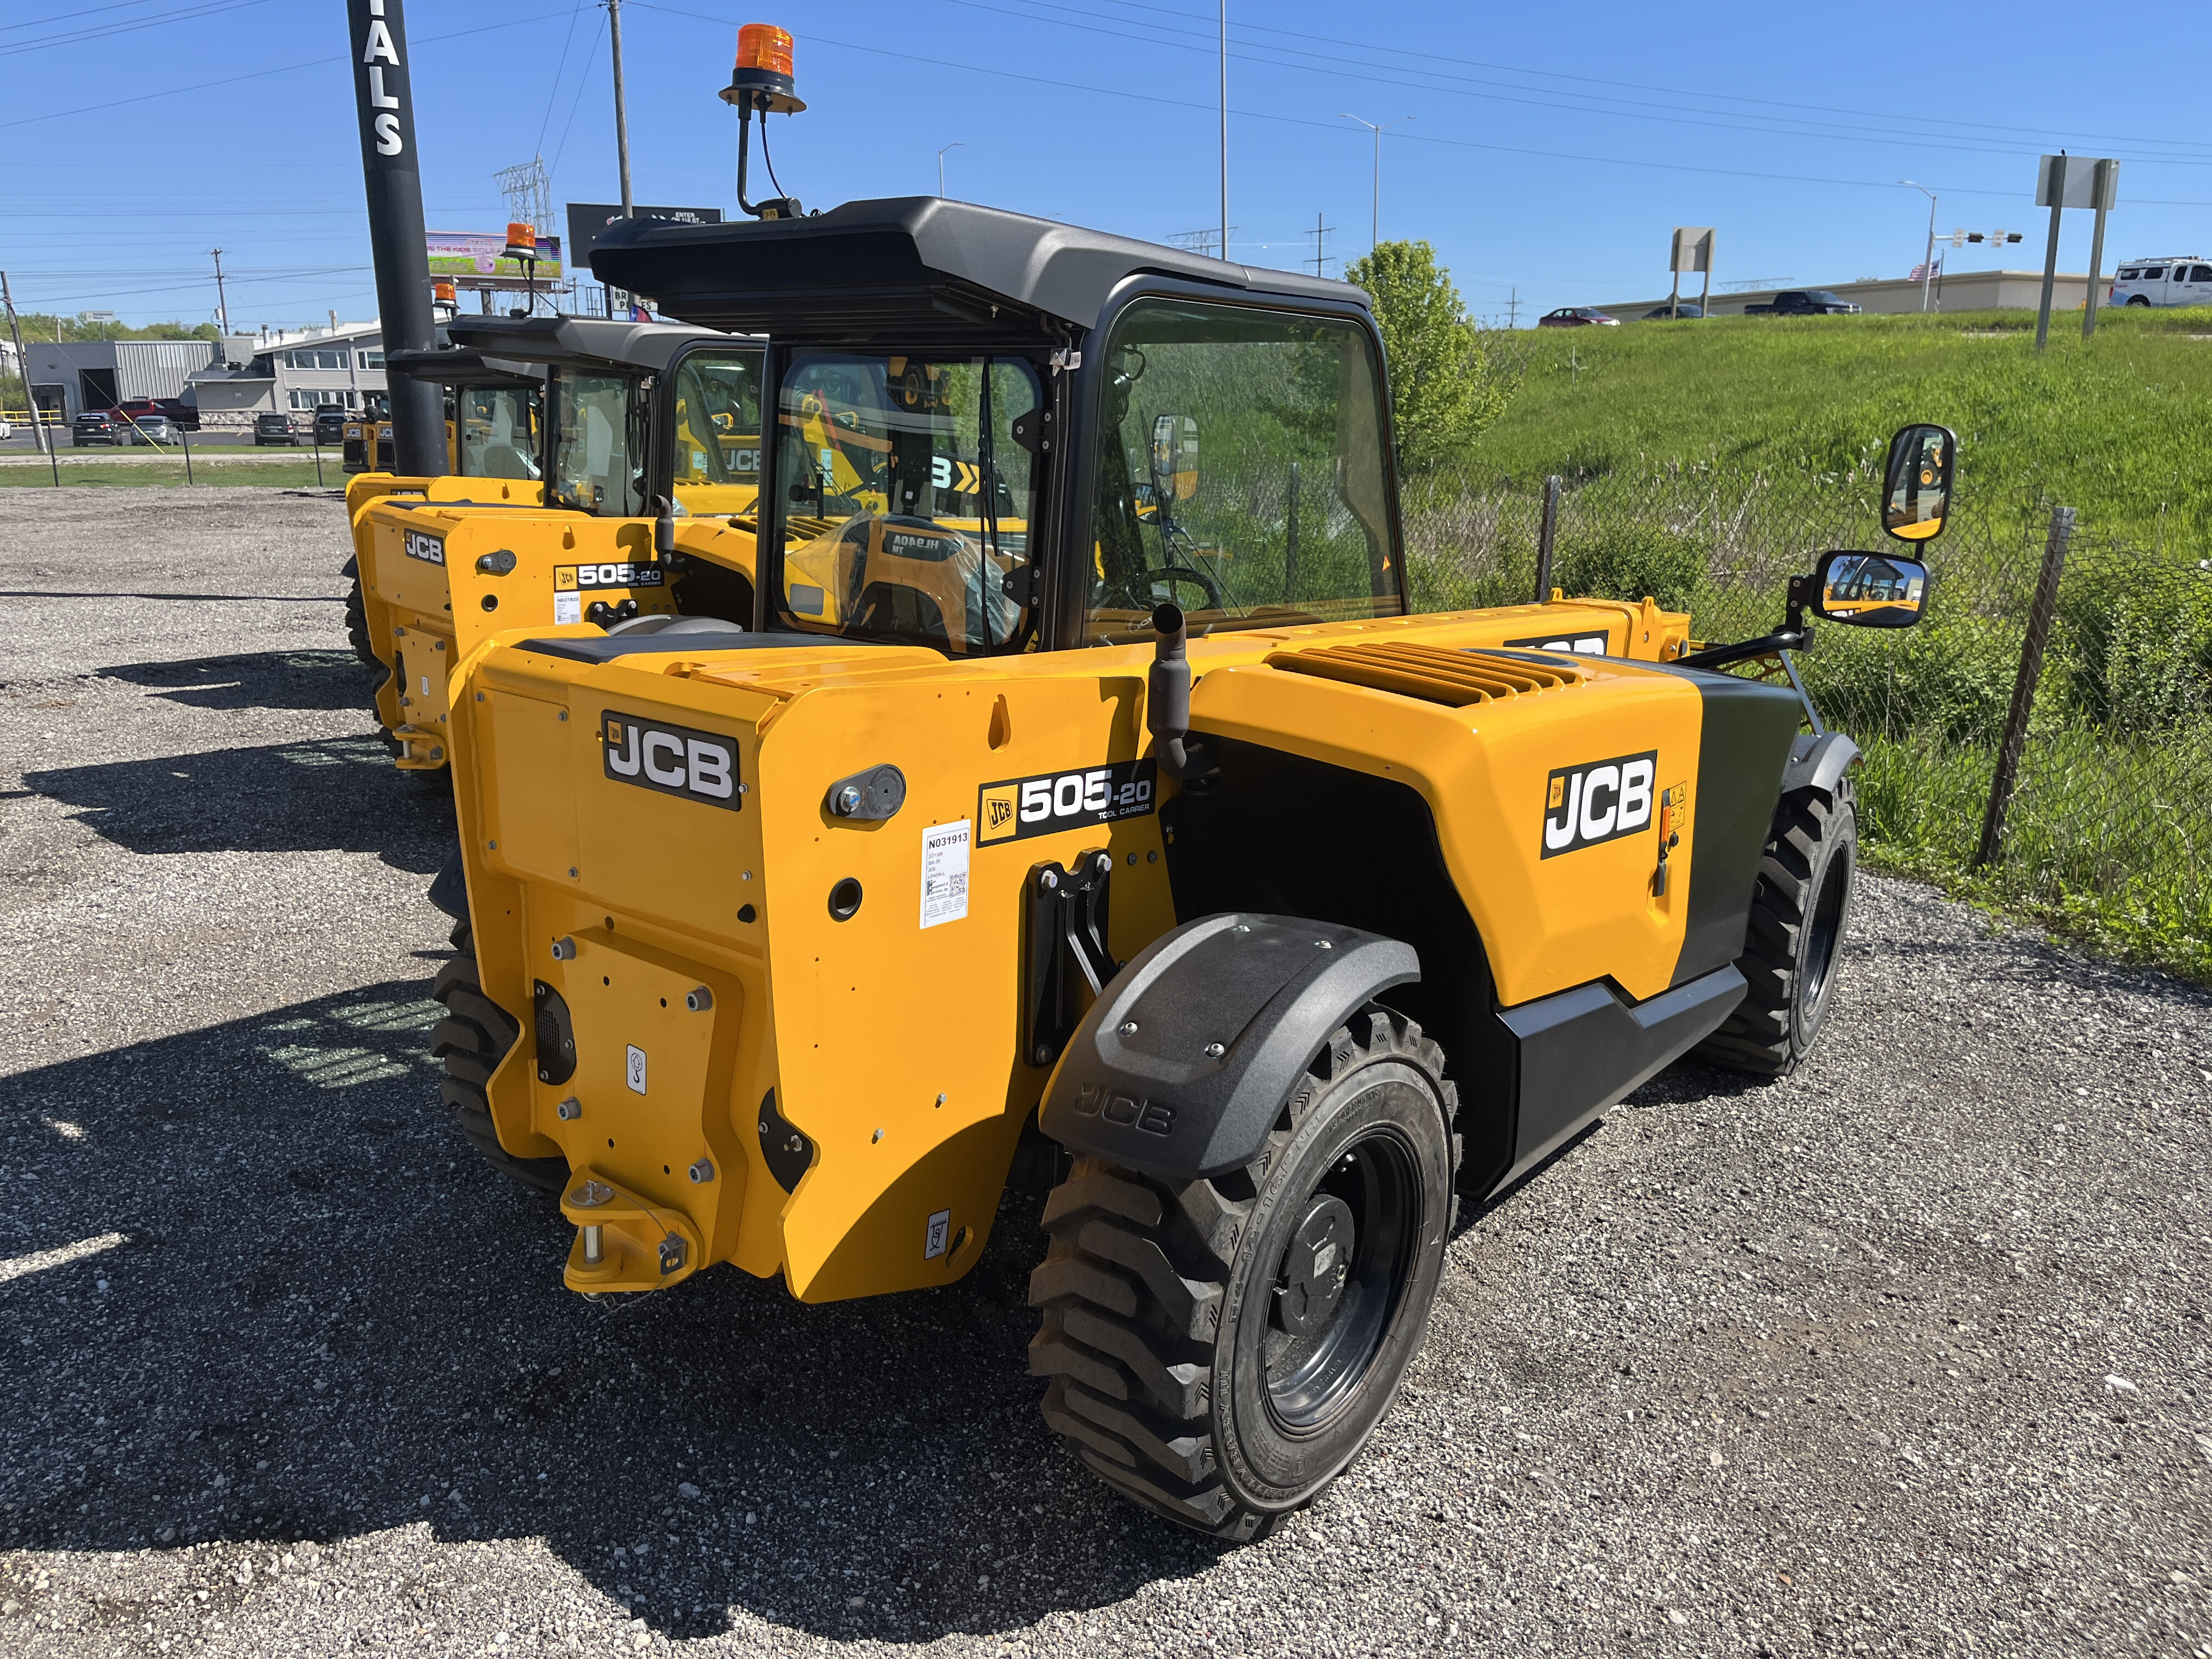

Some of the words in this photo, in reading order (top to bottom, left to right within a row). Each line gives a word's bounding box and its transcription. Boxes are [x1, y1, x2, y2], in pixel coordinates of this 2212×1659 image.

[347, 428, 360, 437] JCB
[380, 428, 393, 437] JC
[406, 534, 443, 563] JCB
[579, 563, 661, 584] 505-20
[608, 725, 732, 799] JCB
[1020, 769, 1150, 822] 505-20
[1545, 759, 1653, 849] JCB
[991, 801, 1011, 826] JCB
[1098, 811, 1117, 820] TOOL
[1120, 804, 1150, 815] CARRIER
[929, 832, 968, 849] N031913
[1074, 1082, 1178, 1137] JCB
[1220, 1403, 1241, 1466] BABY
